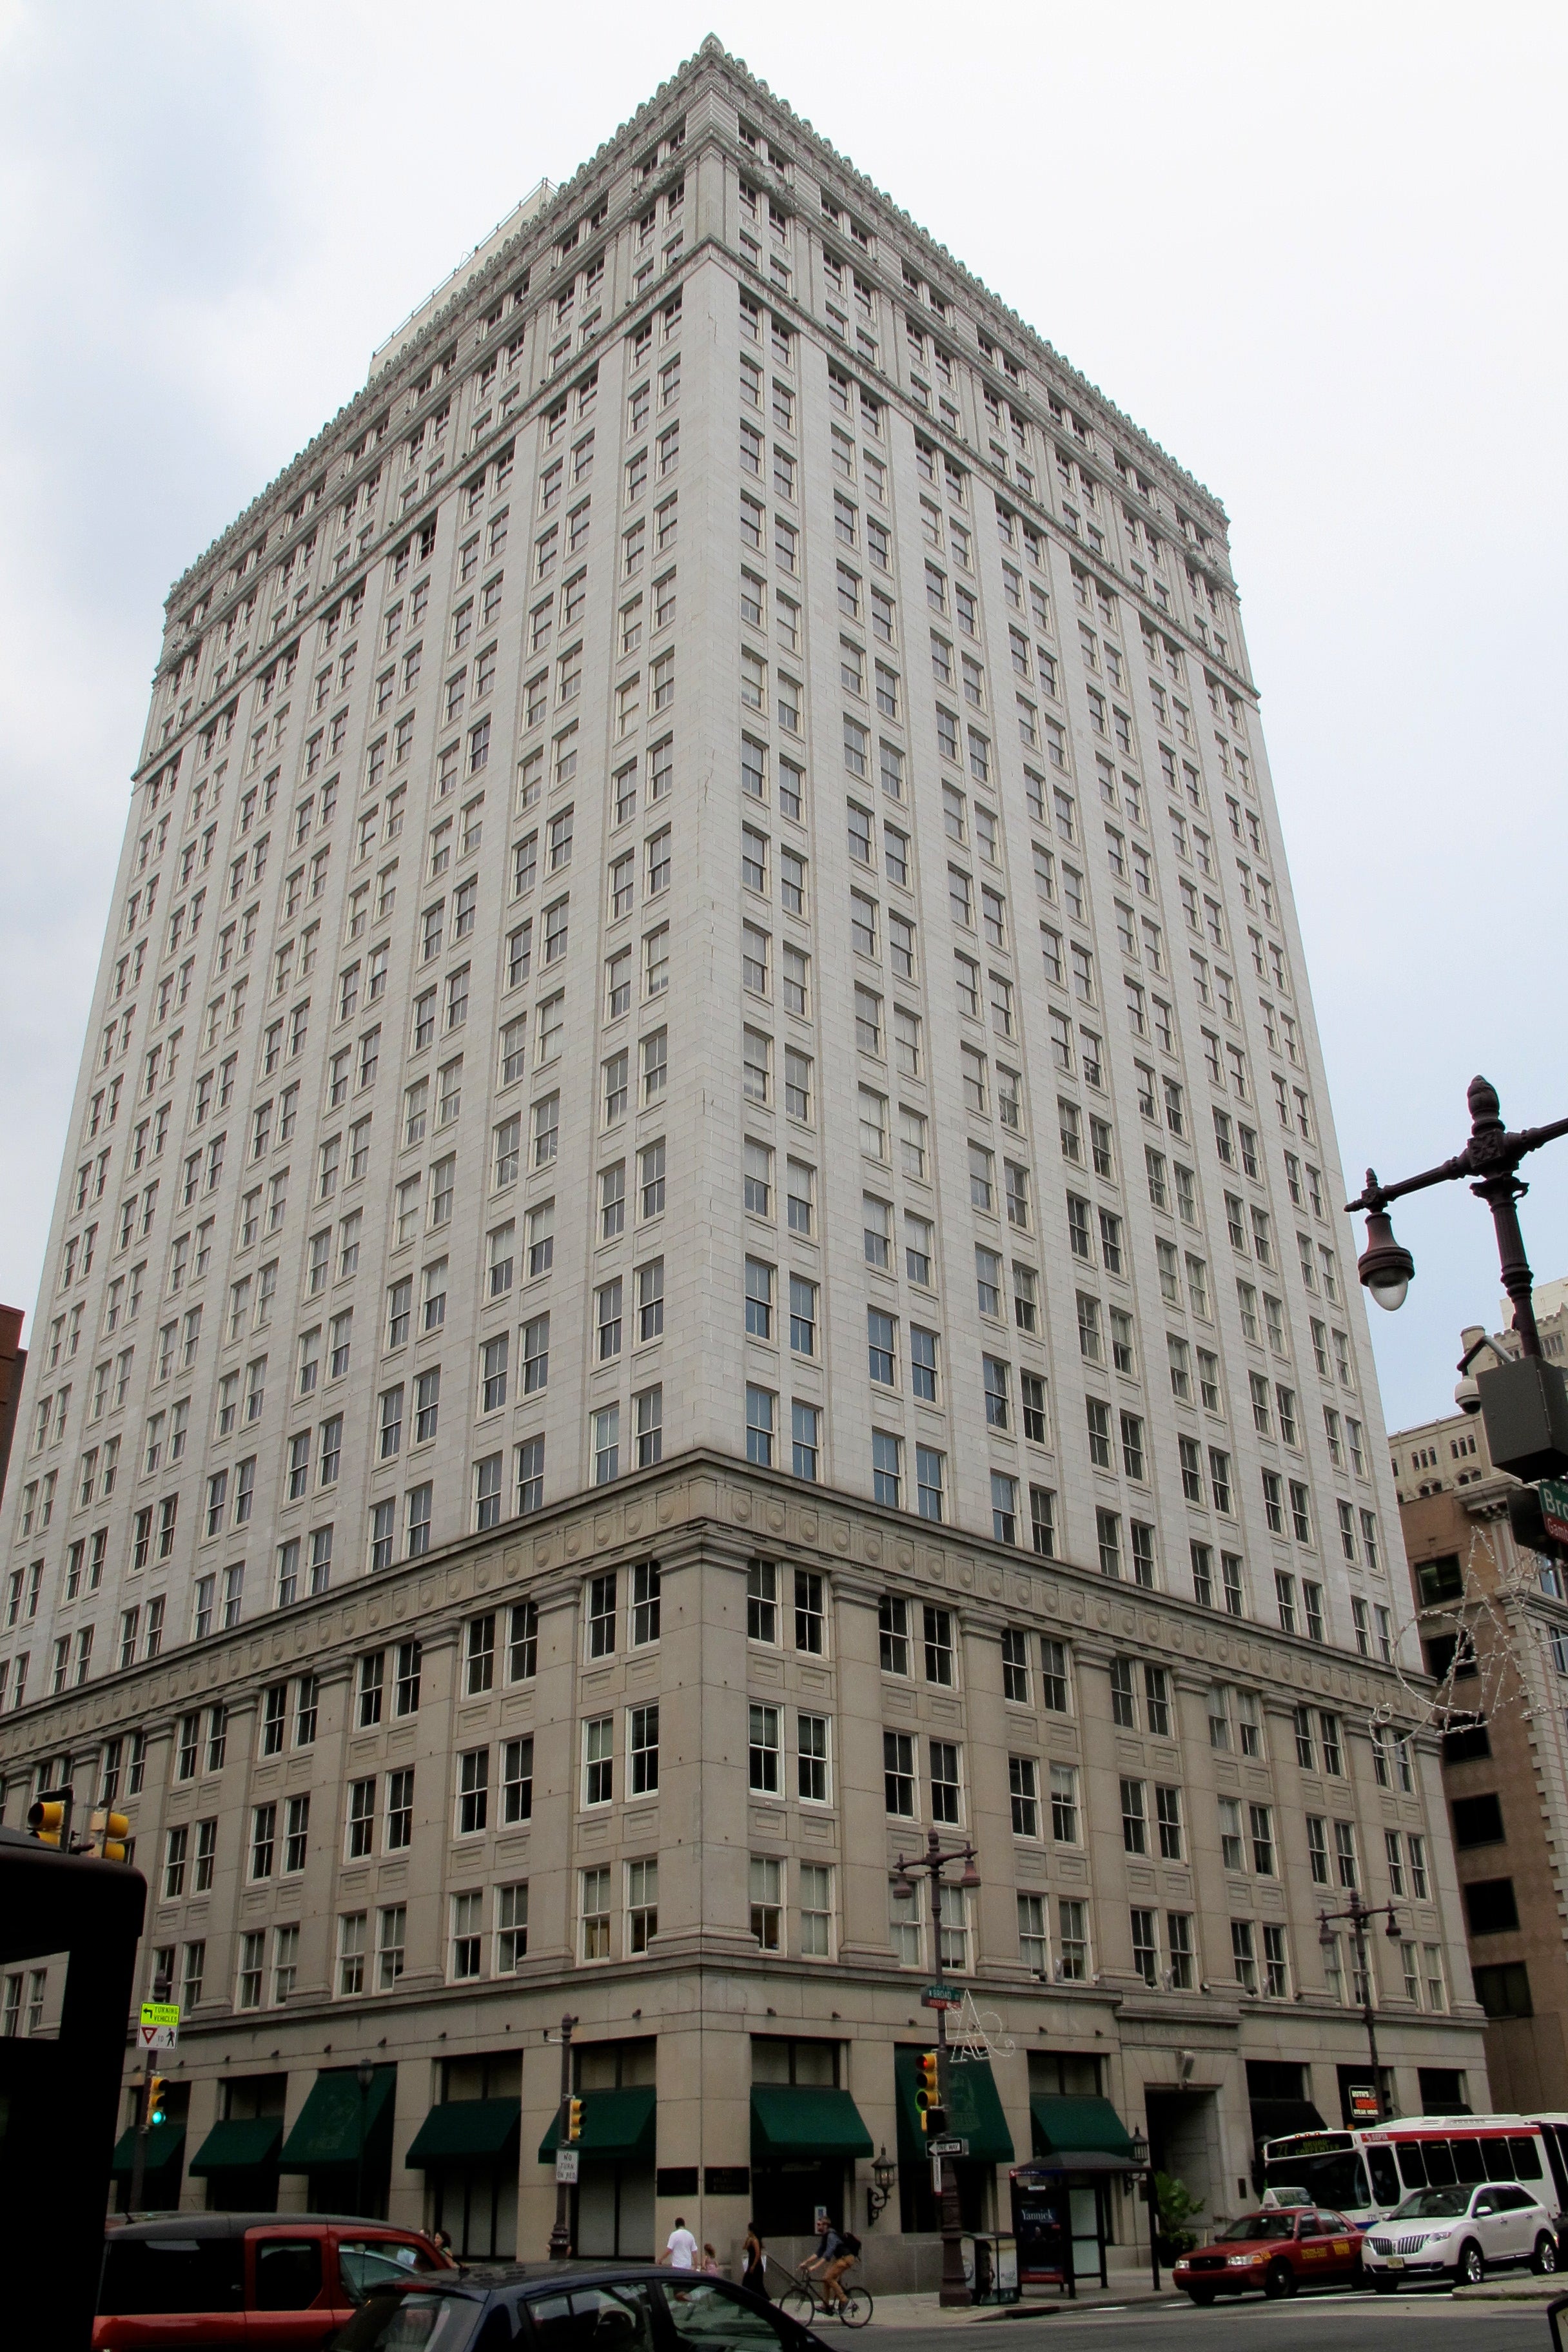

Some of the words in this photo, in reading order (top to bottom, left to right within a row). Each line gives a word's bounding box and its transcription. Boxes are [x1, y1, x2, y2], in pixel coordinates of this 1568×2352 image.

[933, 1990, 952, 2000] BROAD
[1276, 2142, 1288, 2157] 27
[1021, 2208, 1054, 2220] Yannick
